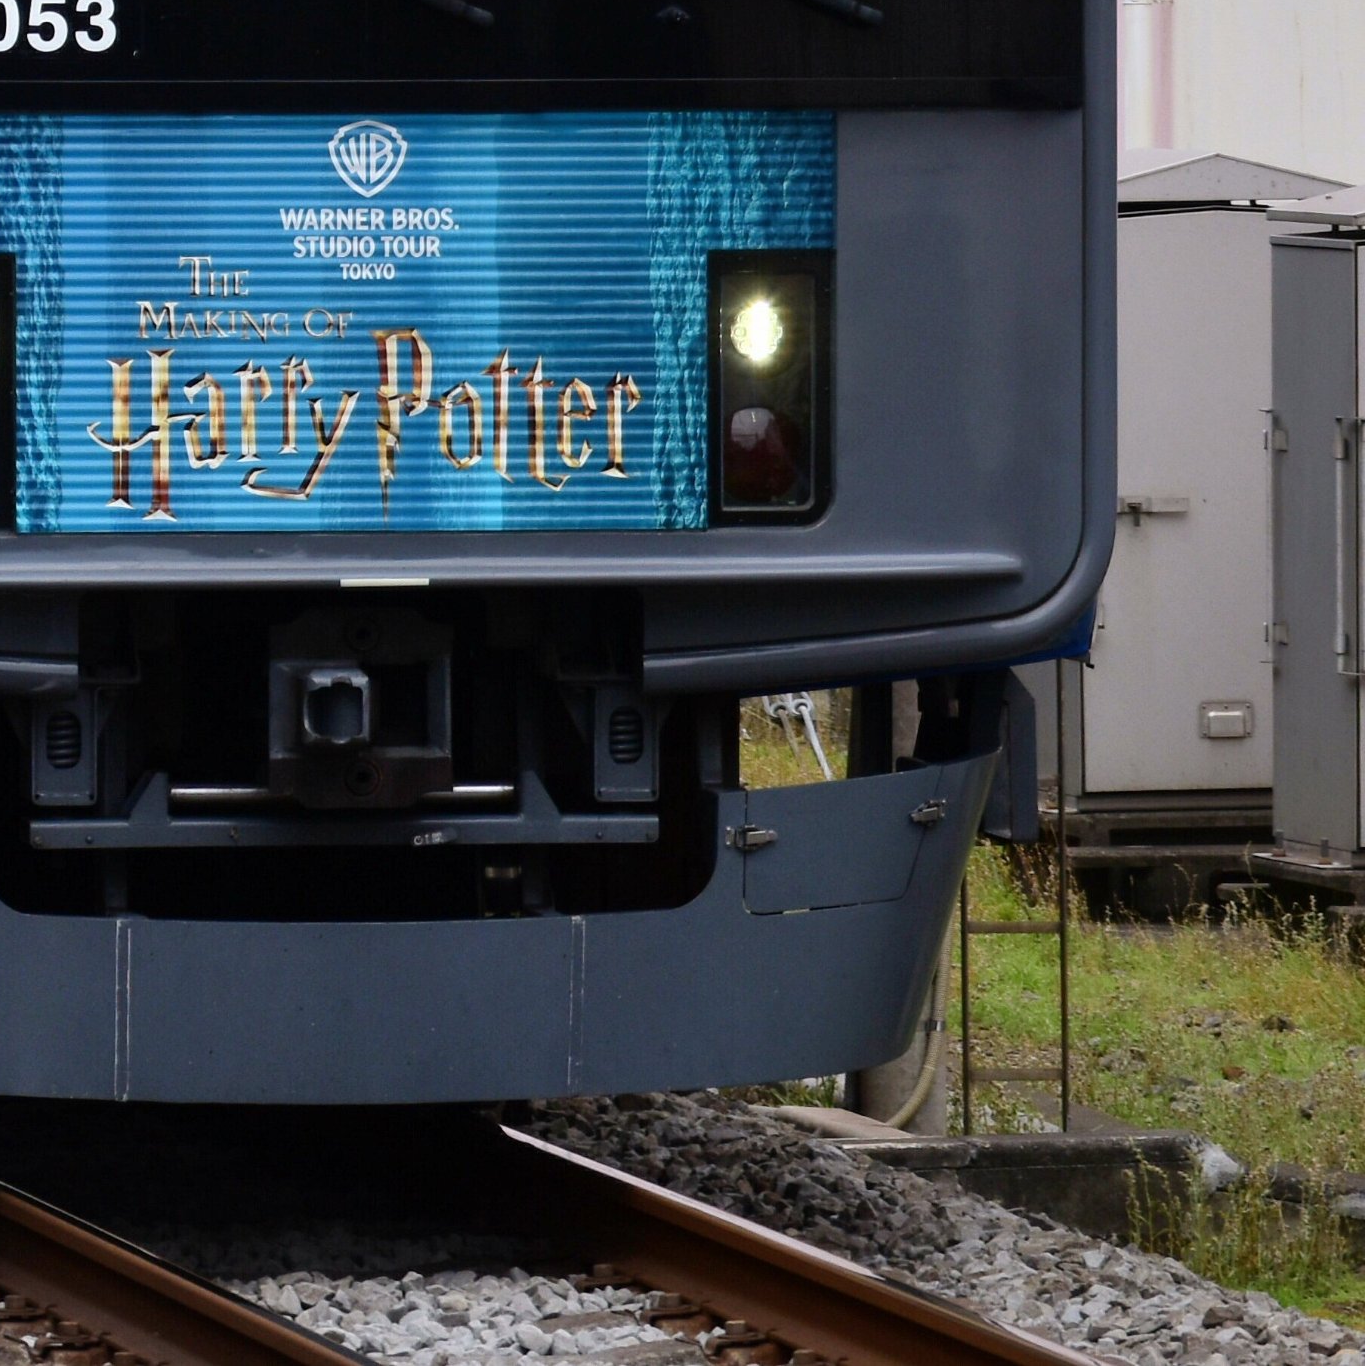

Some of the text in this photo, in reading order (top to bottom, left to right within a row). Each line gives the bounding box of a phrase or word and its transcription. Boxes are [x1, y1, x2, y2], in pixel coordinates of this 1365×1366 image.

[279, 207, 460, 231] WARNER BROS.
[293, 235, 441, 258] STUDIO TOUR
[340, 263, 395, 280] TOKYO
[86, 327, 642, 523] Harry Potter
